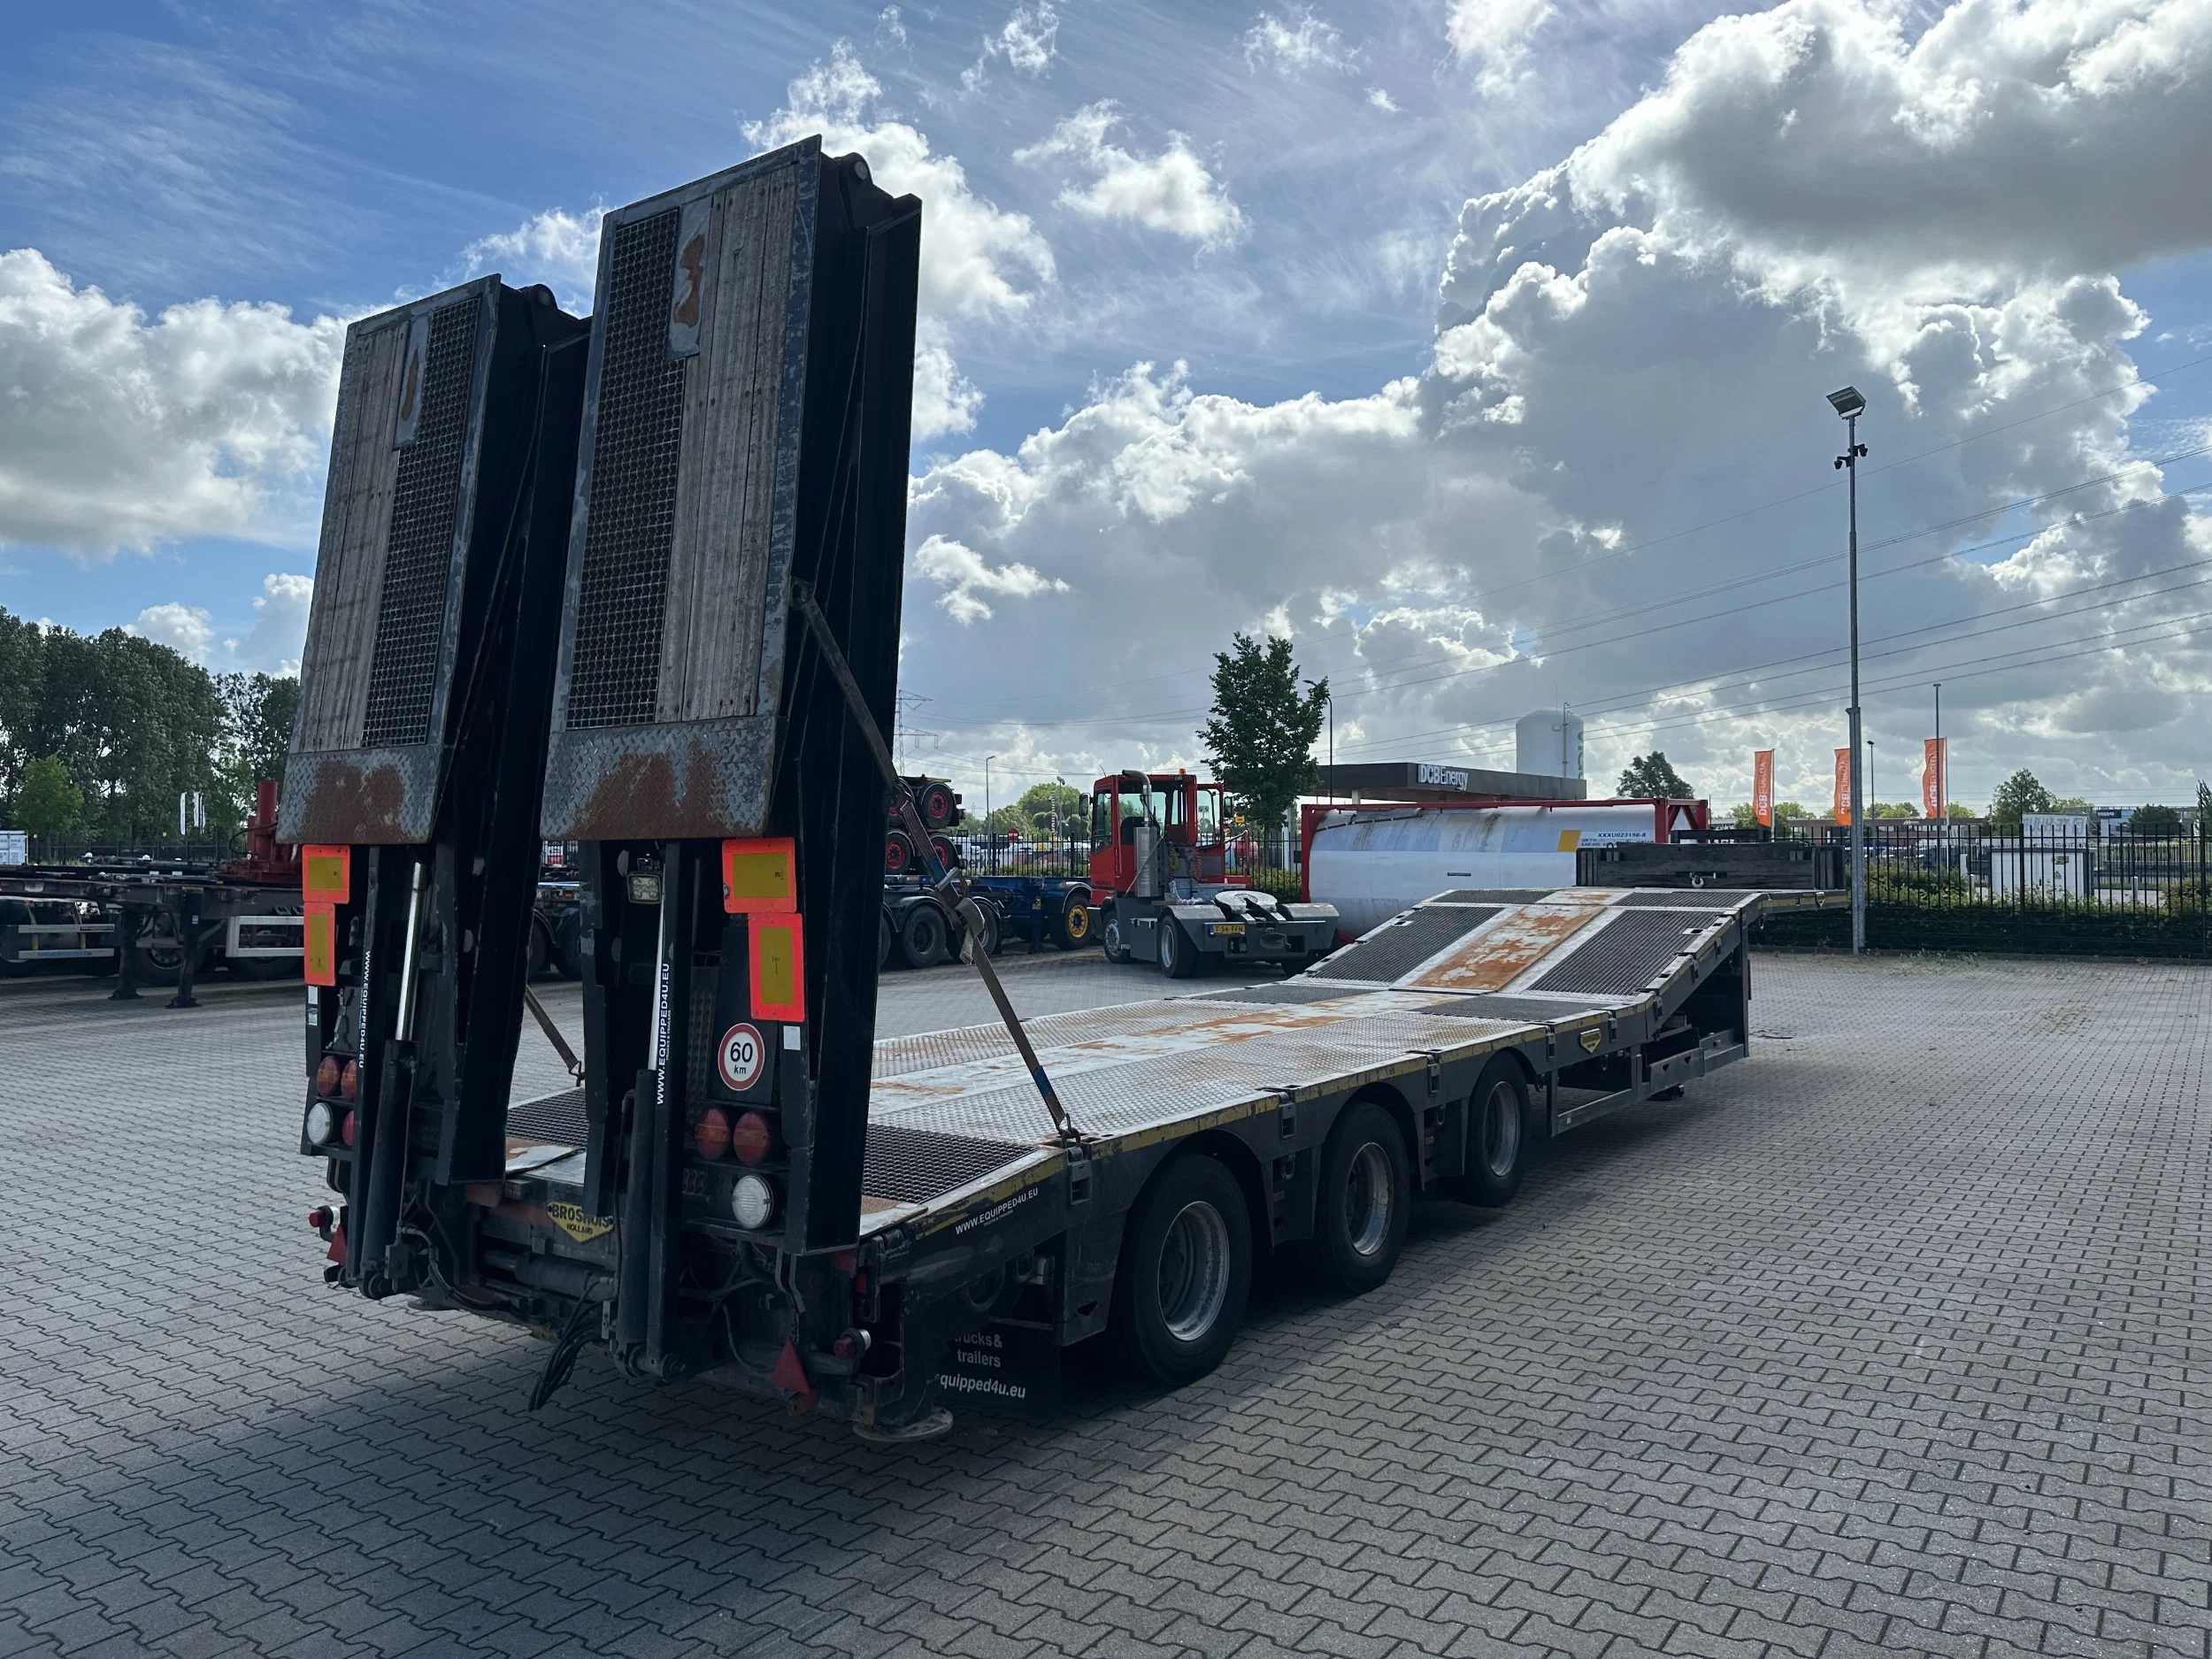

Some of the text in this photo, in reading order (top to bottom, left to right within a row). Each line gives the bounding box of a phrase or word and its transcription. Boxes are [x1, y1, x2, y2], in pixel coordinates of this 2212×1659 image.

[1417, 764, 1469, 791] DCBEnergy
[358, 950, 371, 1068] WWW.EQUIPPED4U.EU
[657, 963, 670, 1105] WWW.EQUIPPED4U.EU
[730, 1041, 753, 1063] 60
[733, 1064, 747, 1074] km
[956, 1187, 1039, 1235] WWW.EQUIPPED4U.EU
[566, 1223, 594, 1235] HOLLAND
[957, 1348, 1001, 1367] trailers
